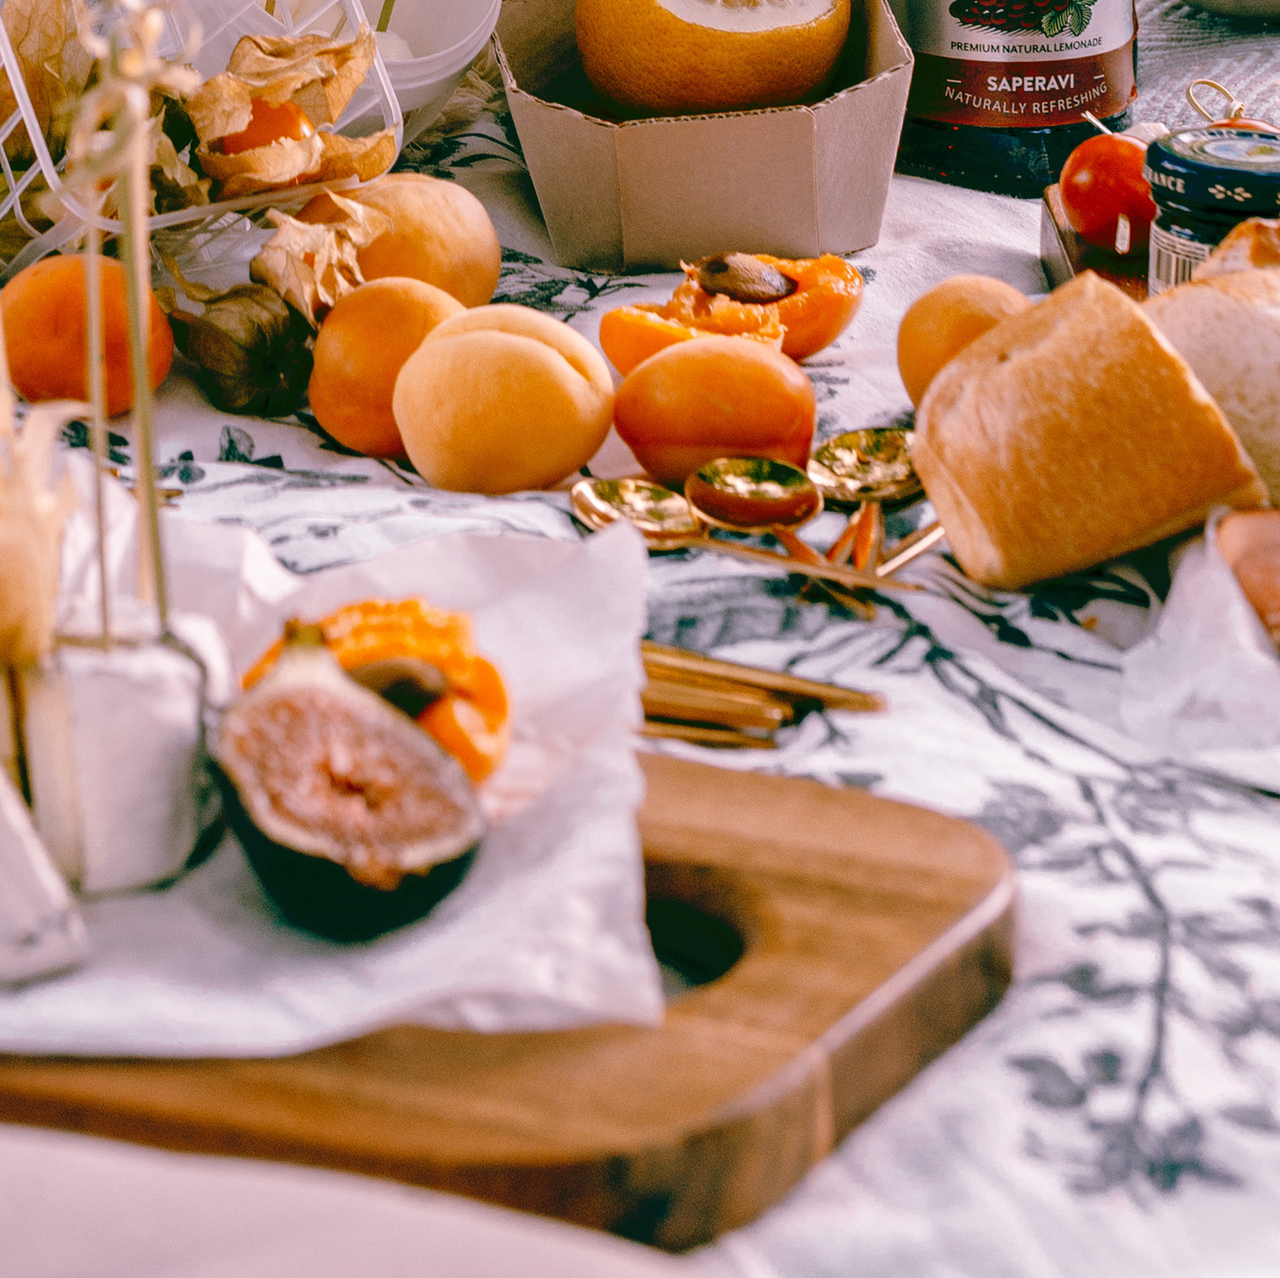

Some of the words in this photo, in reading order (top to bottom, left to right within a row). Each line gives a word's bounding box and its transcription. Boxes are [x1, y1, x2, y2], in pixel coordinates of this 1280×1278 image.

[950, 41, 1000, 53] PREMIUM
[1002, 44, 1052, 54] NATURAL
[1054, 37, 1102, 52] LEMONADE
[987, 74, 1075, 92] SAPERAVI
[945, 86, 1027, 114] NATURALLY
[1032, 81, 1108, 114] REFRESHING
